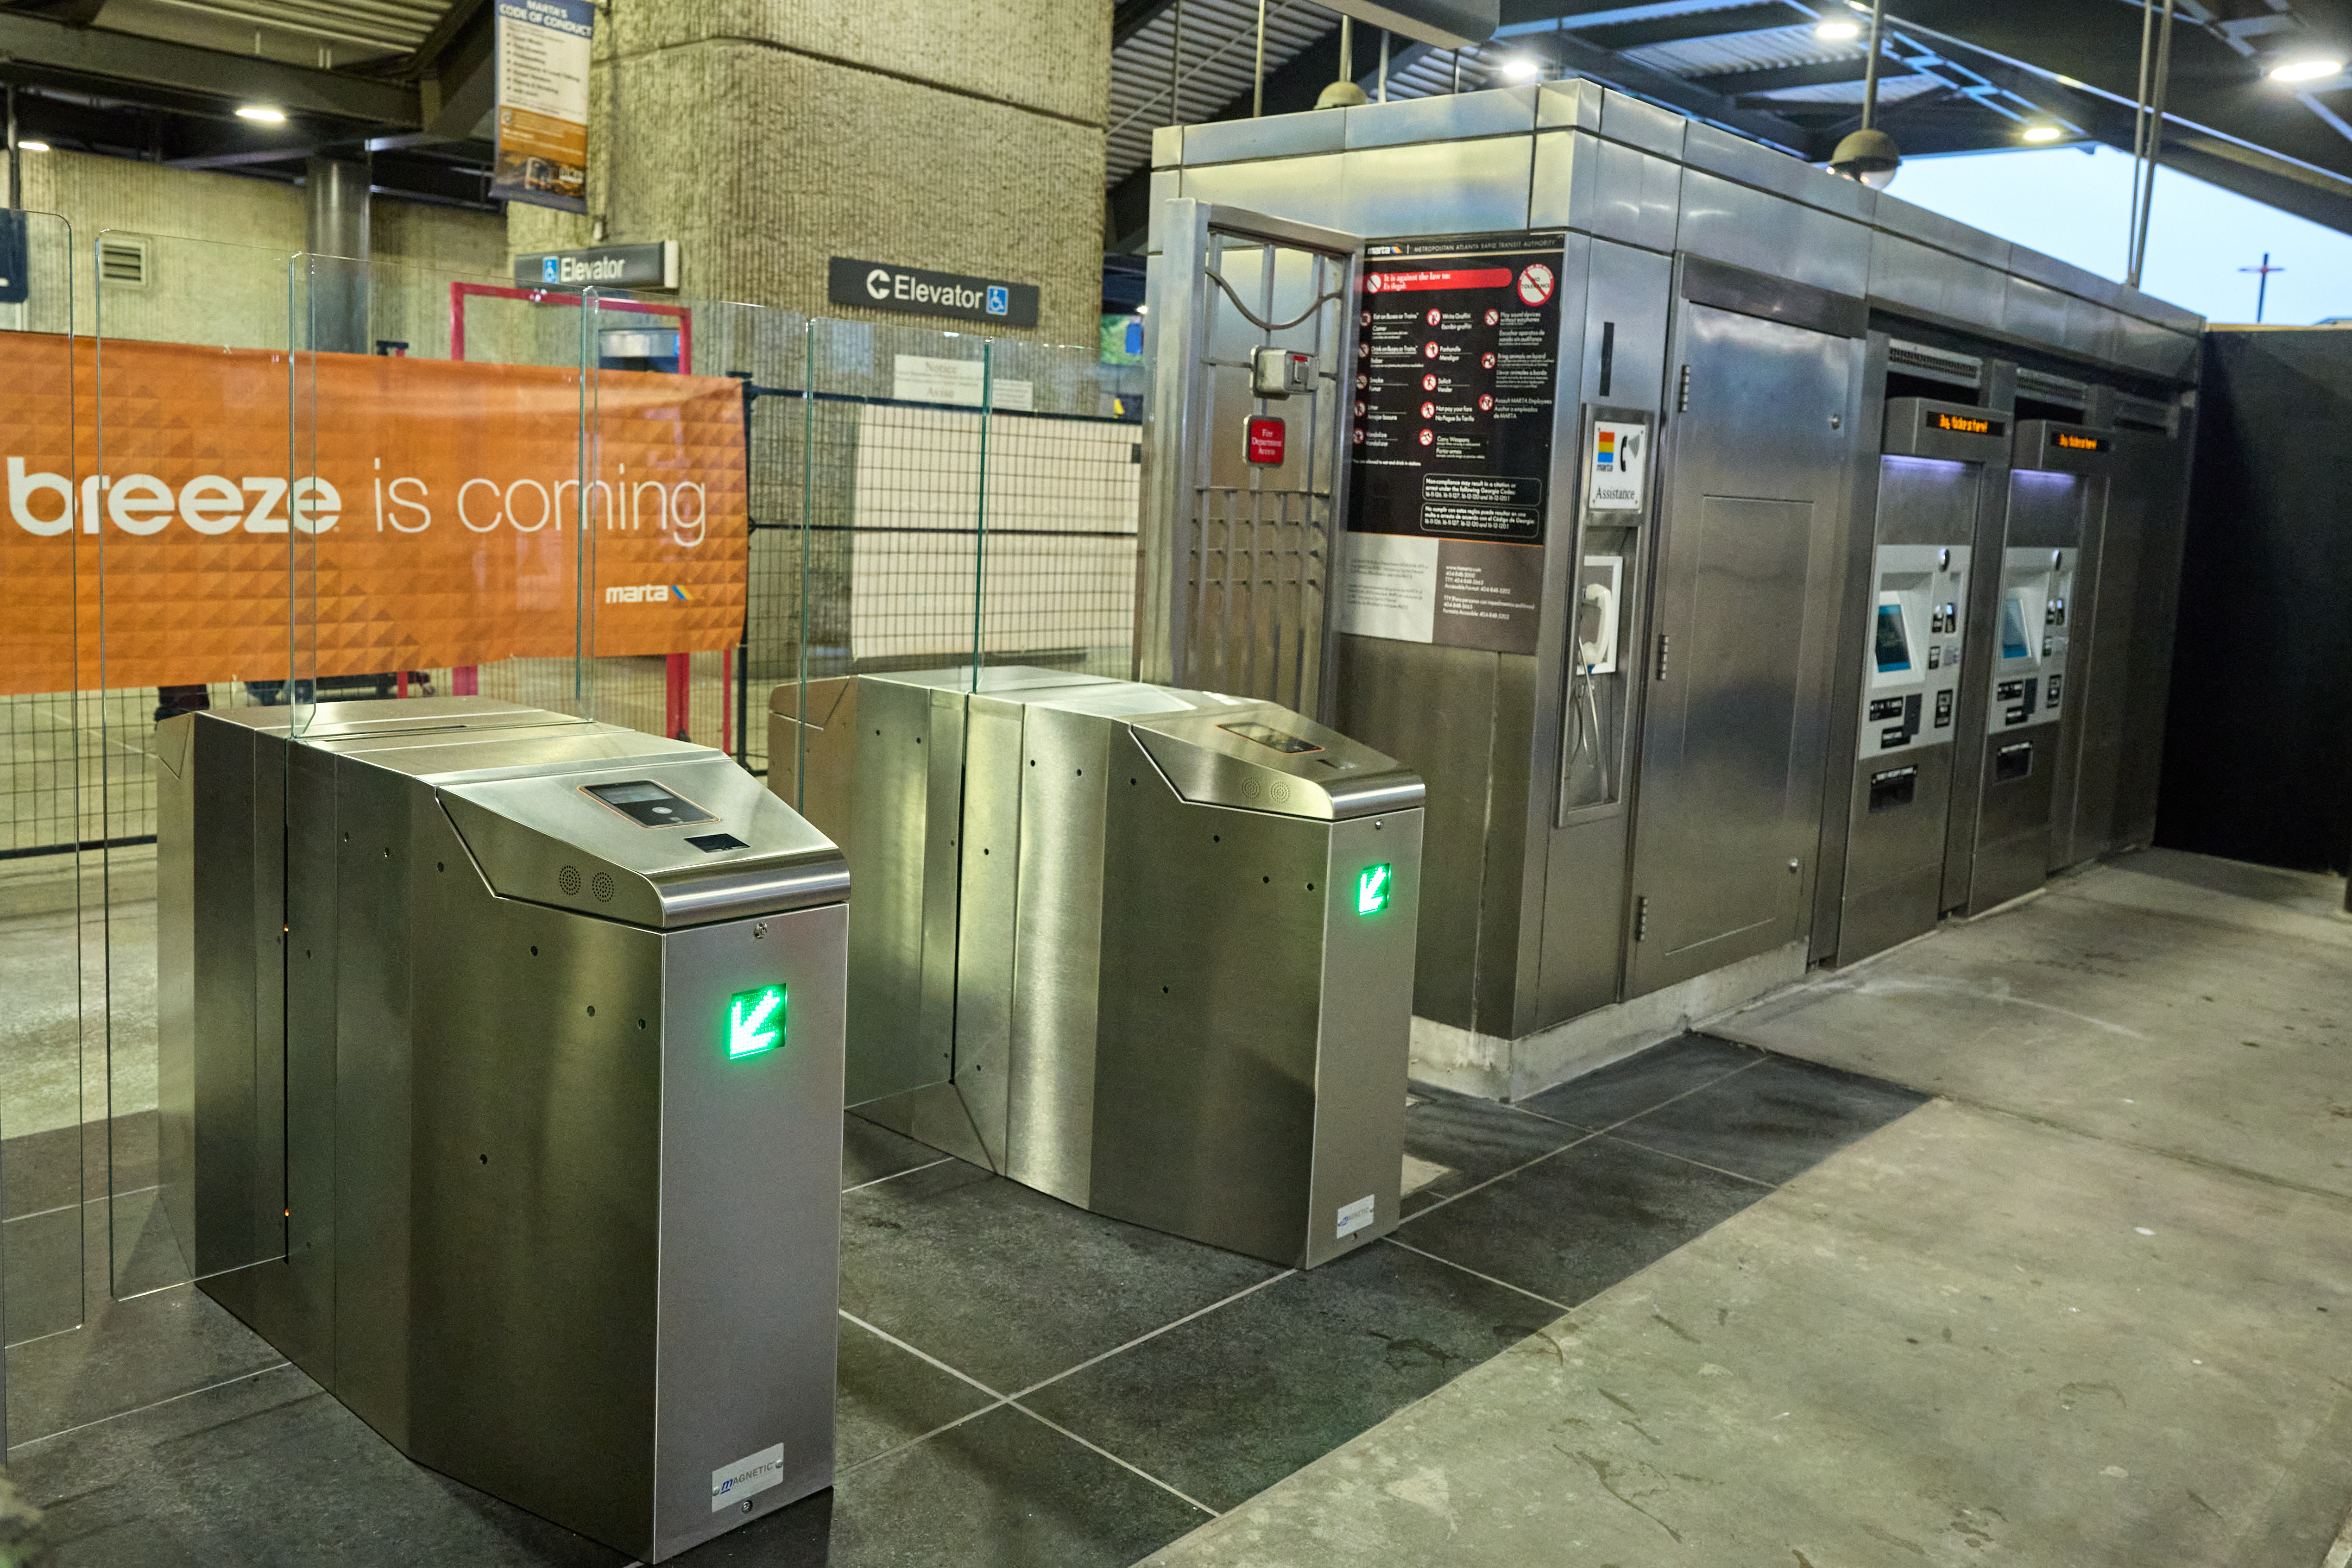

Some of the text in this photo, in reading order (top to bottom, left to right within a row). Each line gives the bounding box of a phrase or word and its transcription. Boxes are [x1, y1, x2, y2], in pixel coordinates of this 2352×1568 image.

[499, 3, 527, 20] CODE
[529, 11, 542, 23] OF
[544, 15, 593, 36] CONDUCT
[561, 256, 625, 282] Elevator
[1397, 274, 1418, 283] against
[1419, 272, 1429, 280] the
[1430, 271, 1441, 280] law
[894, 274, 984, 309] Elevator
[1262, 428, 1274, 437] Fire
[1596, 464, 1613, 472] marta
[7, 456, 706, 547] breeze is coming
[1595, 486, 1635, 499] Assistance
[605, 584, 668, 604] marta
